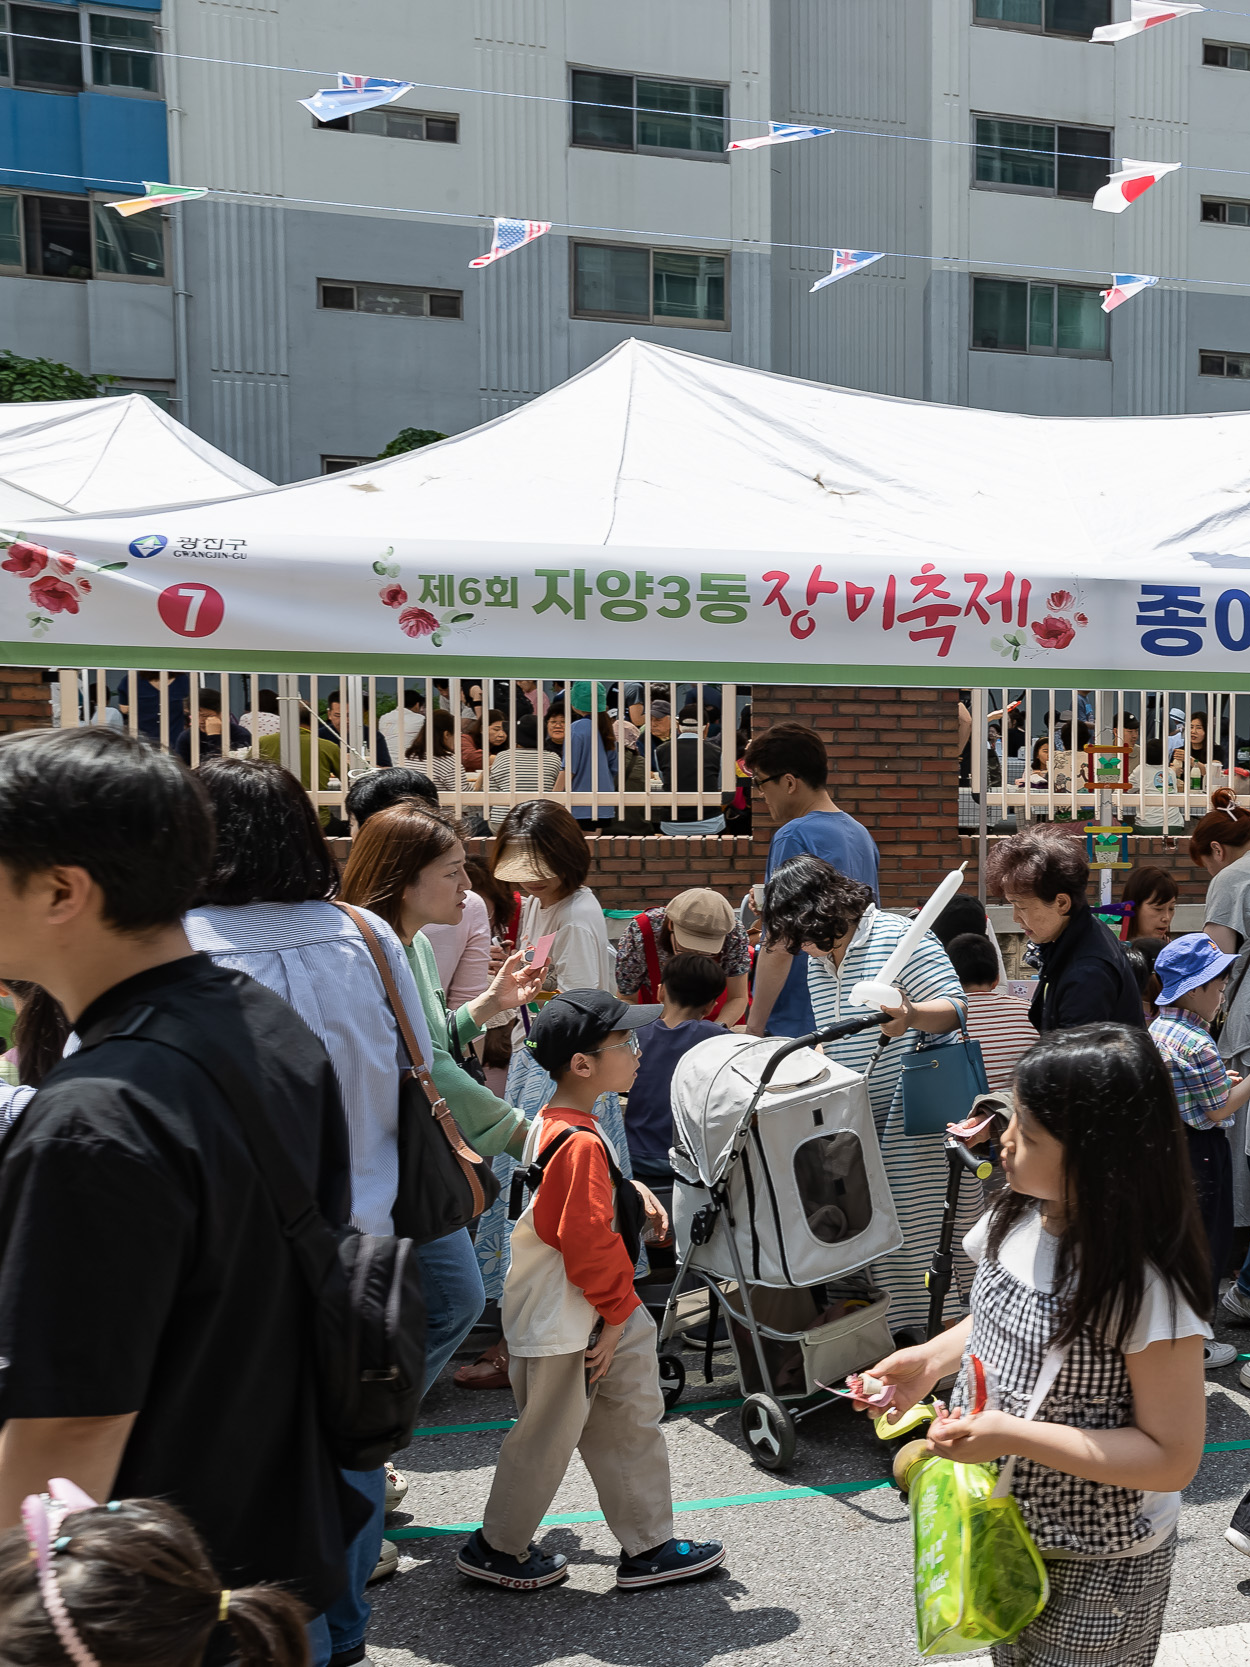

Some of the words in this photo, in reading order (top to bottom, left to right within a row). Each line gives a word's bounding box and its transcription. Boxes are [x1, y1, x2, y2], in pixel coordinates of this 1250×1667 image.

[176, 536, 248, 551] 광진구
[173, 549, 248, 560] GWANGJIN-GU
[178, 588, 207, 632] 7
[418, 574, 518, 609] 제6회
[533, 568, 751, 623] 자양3동
[761, 564, 1032, 657] 장미축제
[499, 1576, 539, 1589] crocs
